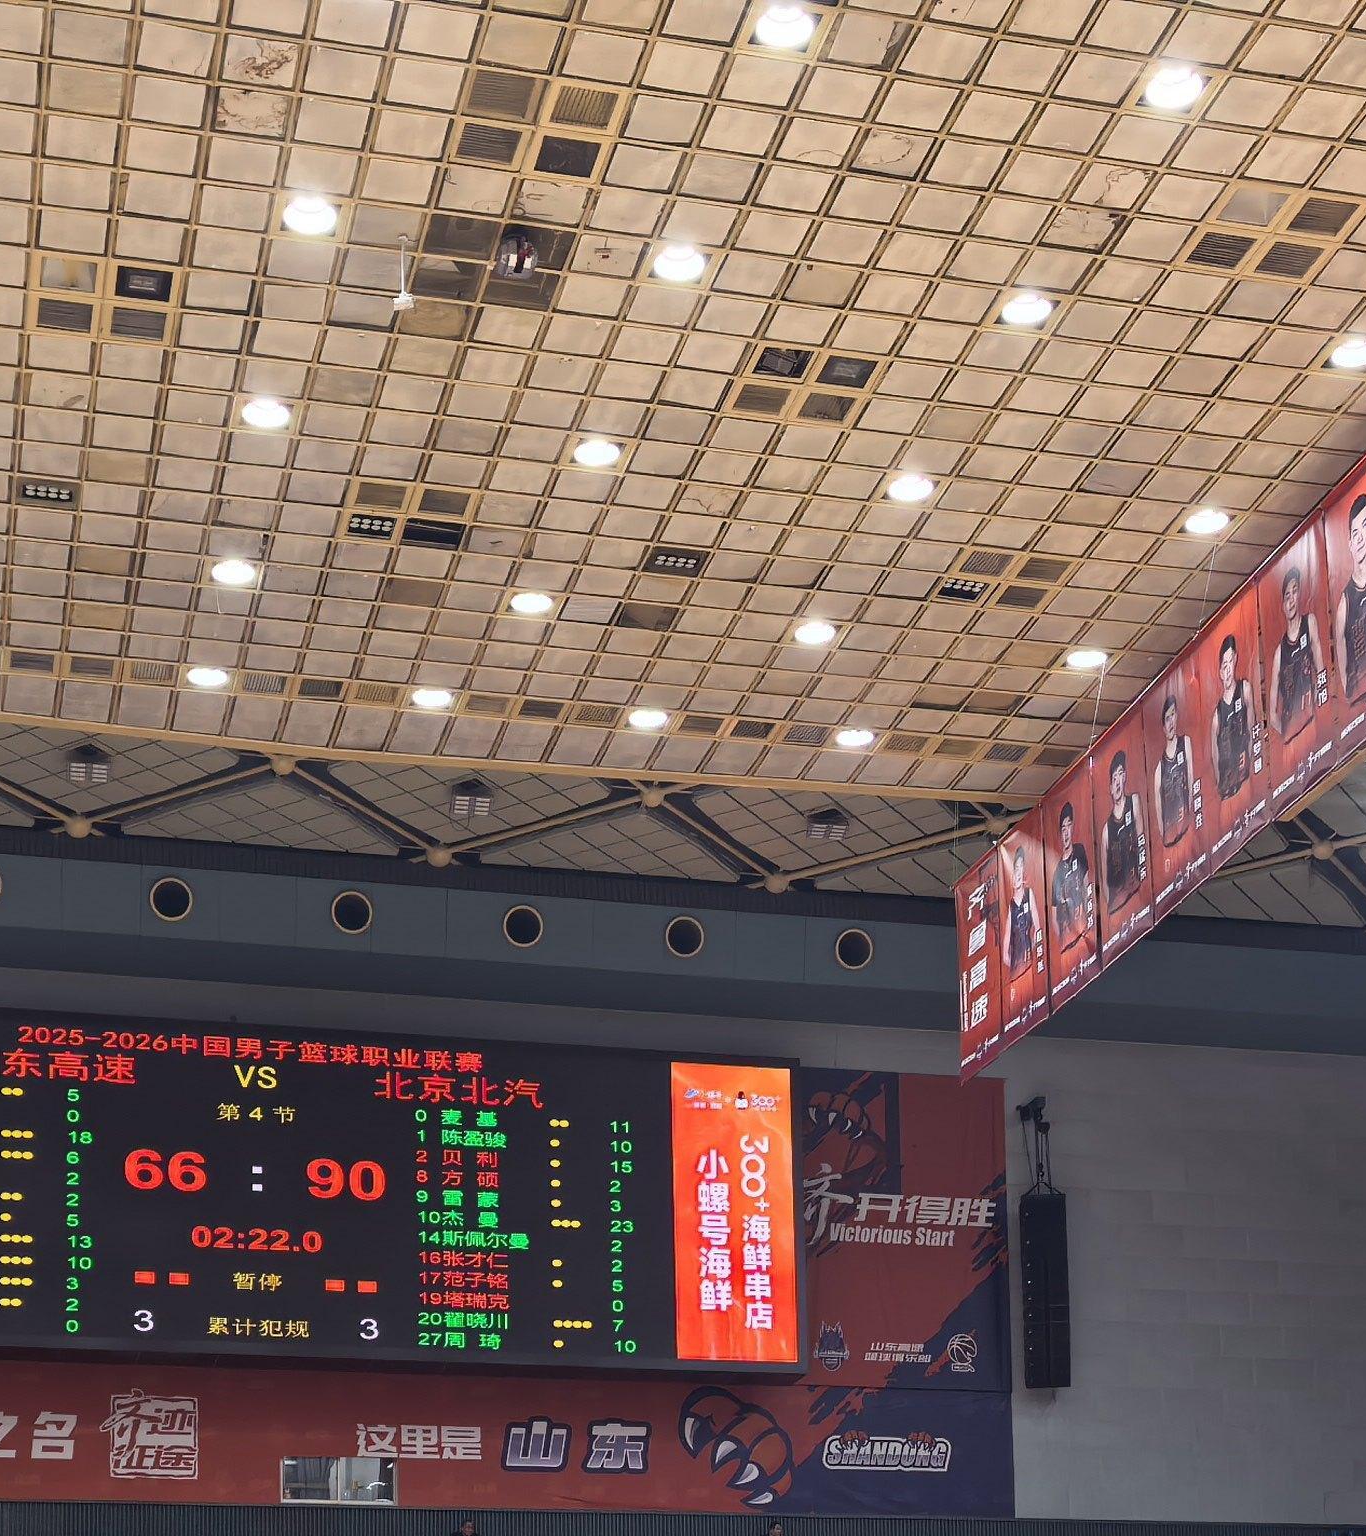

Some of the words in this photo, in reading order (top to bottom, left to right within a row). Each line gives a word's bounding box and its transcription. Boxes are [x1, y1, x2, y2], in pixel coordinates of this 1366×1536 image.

[234, 1065, 278, 1089] VS
[66, 1089, 79, 1102] 5
[375, 1071, 543, 1109] 北京北汽
[66, 1110, 79, 1122] 0
[415, 1109, 427, 1122] 0
[610, 1121, 630, 1133] 11
[68, 1131, 93, 1145] 18
[417, 1130, 426, 1142] 1
[441, 1129, 507, 1148] 陈盈骏
[610, 1141, 632, 1153] 10
[66, 1151, 79, 1164] 6
[416, 1150, 427, 1162] 2
[610, 1161, 633, 1173] 15
[66, 1172, 79, 1185] 2
[124, 1149, 207, 1192] 66
[306, 1158, 386, 1201] 90
[416, 1170, 428, 1183] 8
[609, 1180, 621, 1192] 2
[66, 1194, 79, 1206] 2
[416, 1190, 428, 1202] 9
[610, 1200, 621, 1212] 3
[66, 1214, 79, 1227] 5
[418, 1211, 441, 1223] 10
[610, 1220, 634, 1233] 23
[697, 1149, 733, 1312] 小螺号海鲜
[68, 1235, 92, 1249] 13
[191, 1225, 323, 1253] 02:22.0
[419, 1231, 440, 1244] 14
[611, 1240, 622, 1252] 2
[830, 1222, 911, 1246] Victorious
[915, 1227, 955, 1247] Start
[68, 1256, 92, 1270] 10
[419, 1251, 441, 1264] 16
[443, 1251, 509, 1268] 张才仁
[611, 1260, 622, 1272] 2
[66, 1277, 79, 1290] 3
[233, 1271, 282, 1292] 暂停
[419, 1272, 441, 1285] 17
[443, 1271, 509, 1289] 范子铭
[612, 1280, 623, 1292] 5
[66, 1298, 79, 1311] 2
[419, 1292, 442, 1304] 19
[612, 1300, 624, 1312] 0
[66, 1319, 79, 1332] 0
[133, 1309, 154, 1332] 3
[206, 1316, 310, 1339] 累计犯规
[359, 1318, 380, 1341] 3
[418, 1313, 442, 1325] 20
[612, 1320, 624, 1332] 7
[418, 1333, 442, 1346] 27
[614, 1340, 637, 1353] 10
[355, 1424, 482, 1461] 这里是
[824, 1437, 947, 1469] SHANDONG
